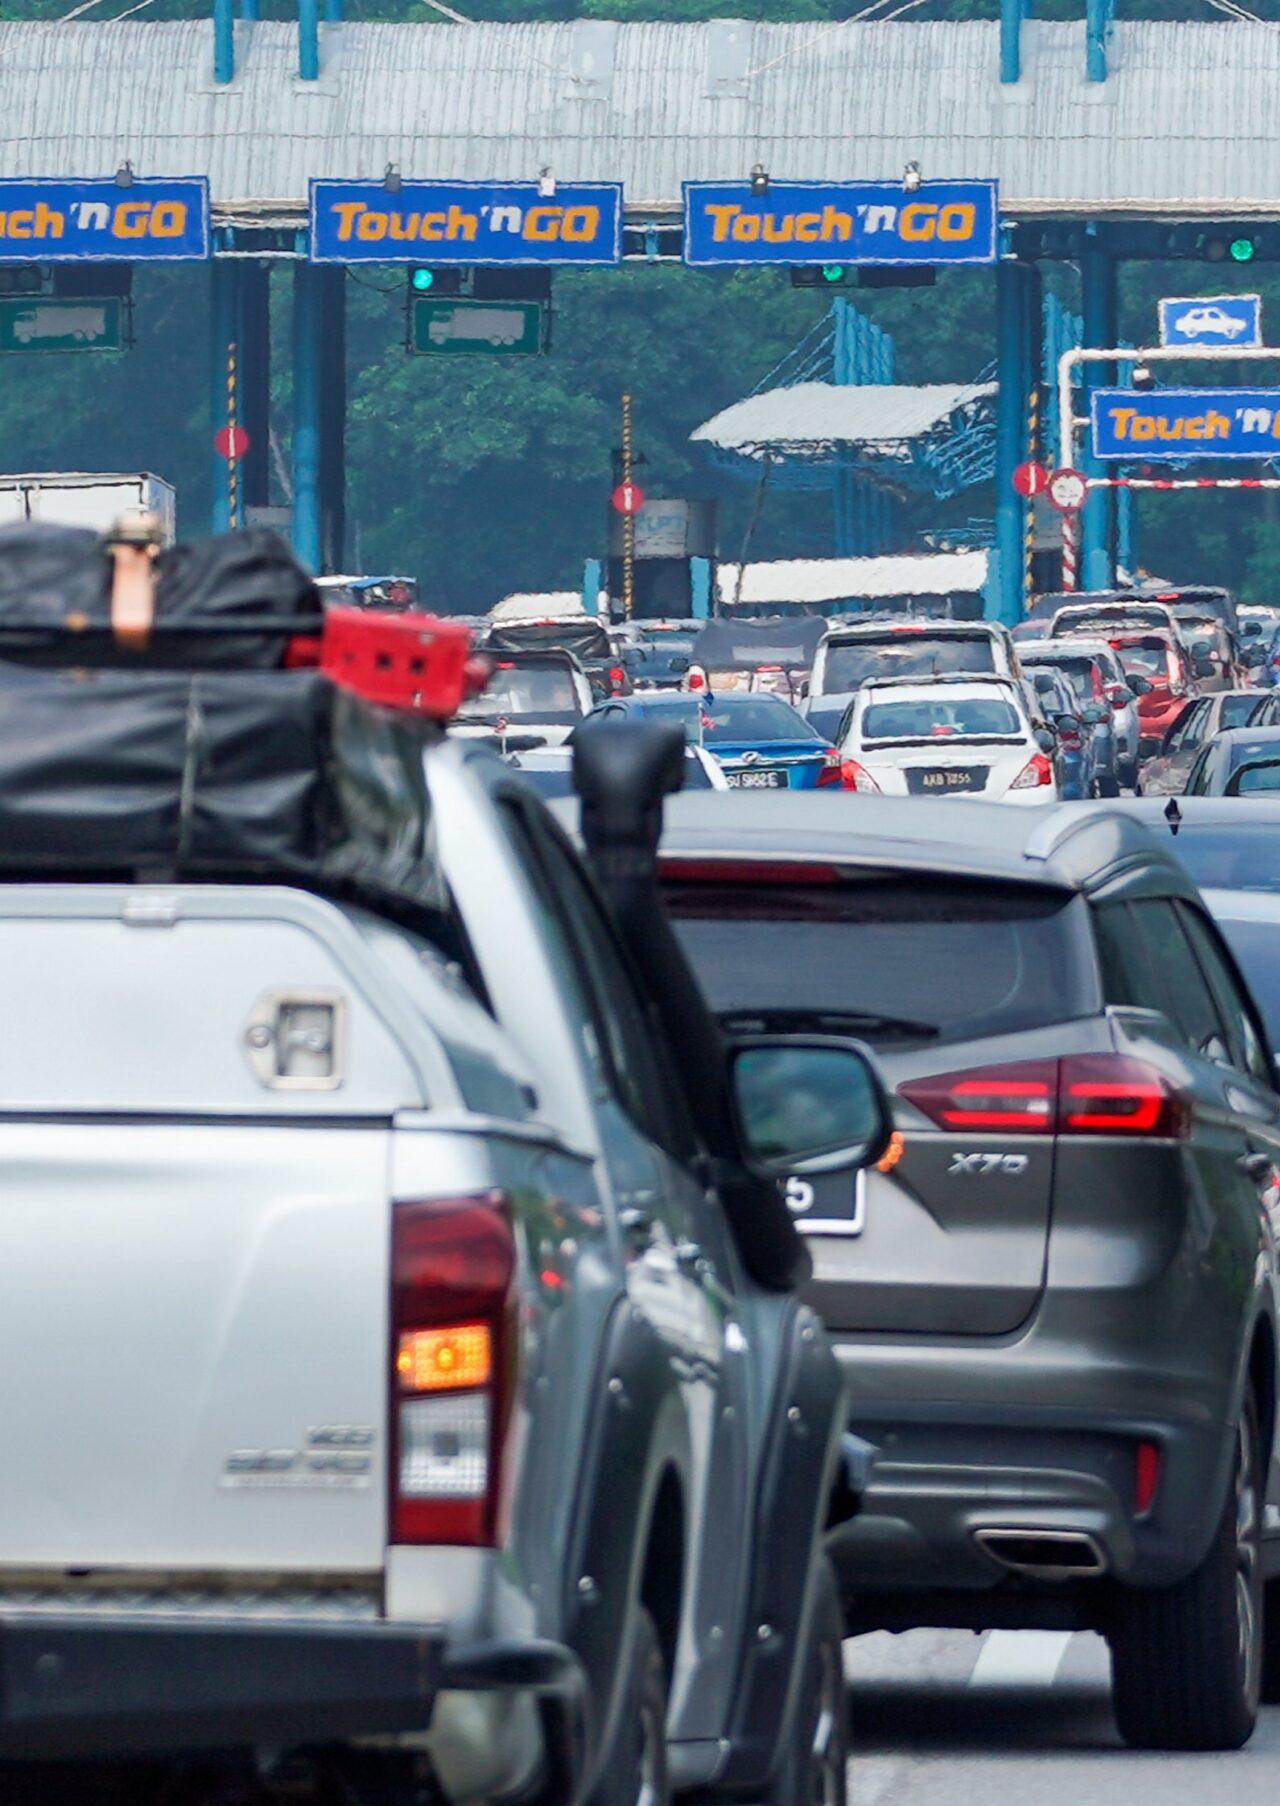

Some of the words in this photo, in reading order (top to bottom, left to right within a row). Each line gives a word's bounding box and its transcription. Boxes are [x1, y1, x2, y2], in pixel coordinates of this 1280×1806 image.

[0, 203, 65, 239] ch
[112, 200, 188, 239] GO
[331, 202, 478, 242] Touch
[522, 204, 600, 243] GO
[704, 204, 852, 244] Touch
[898, 202, 976, 243] GO
[1107, 407, 1230, 442] Touch
